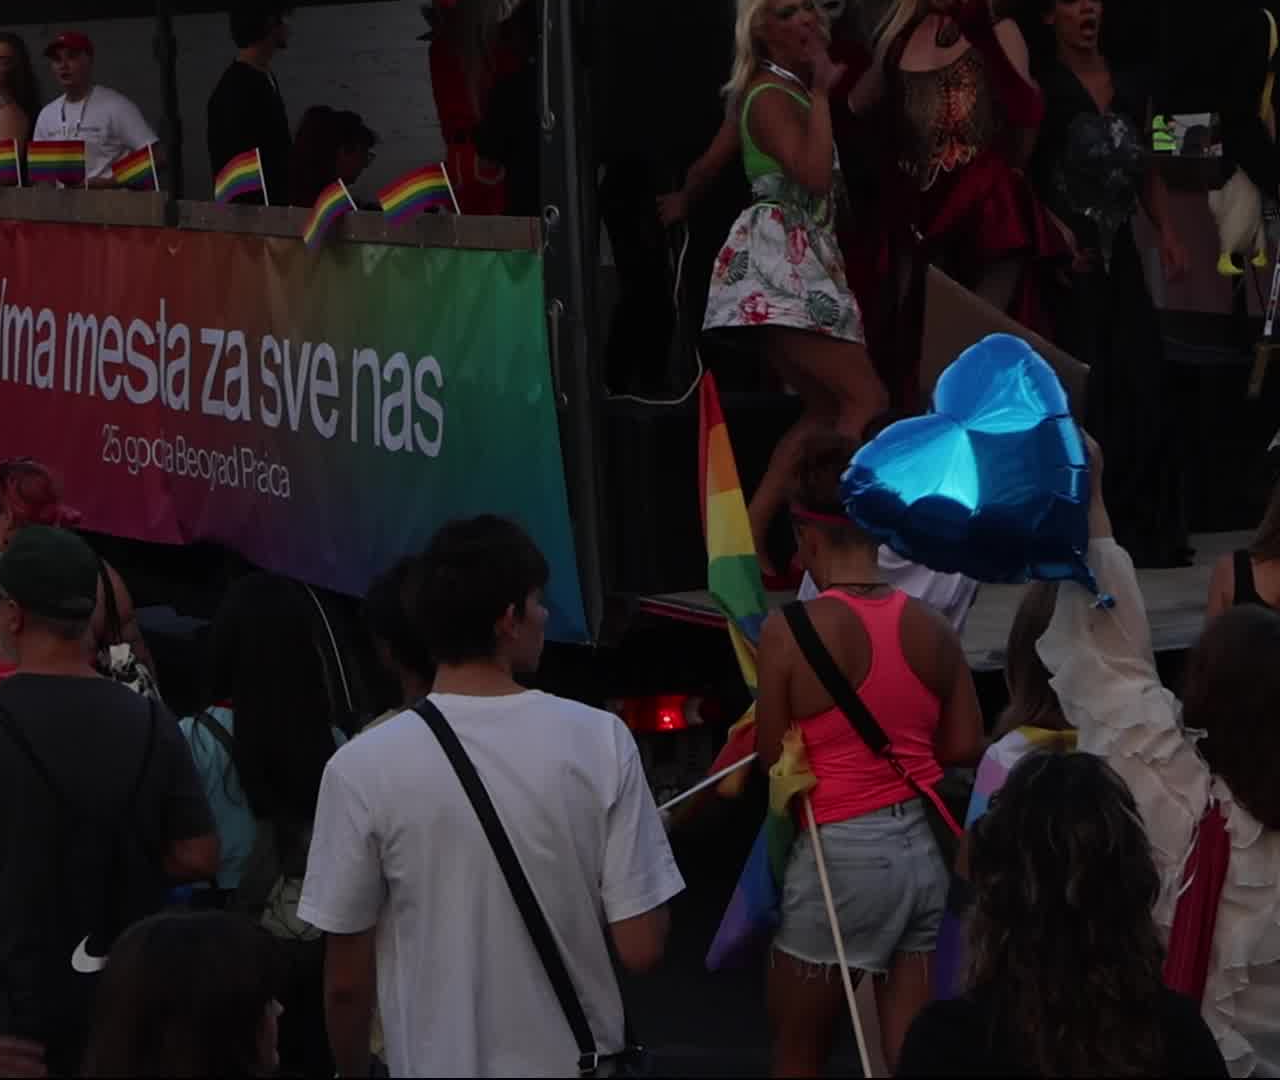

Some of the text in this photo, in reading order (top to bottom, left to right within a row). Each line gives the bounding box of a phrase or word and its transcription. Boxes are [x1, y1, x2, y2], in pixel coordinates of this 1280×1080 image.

[64, 297, 190, 411] mesta
[200, 328, 251, 420] za
[260, 333, 339, 439] sve
[351, 347, 444, 457] nas
[102, 424, 121, 464] 25
